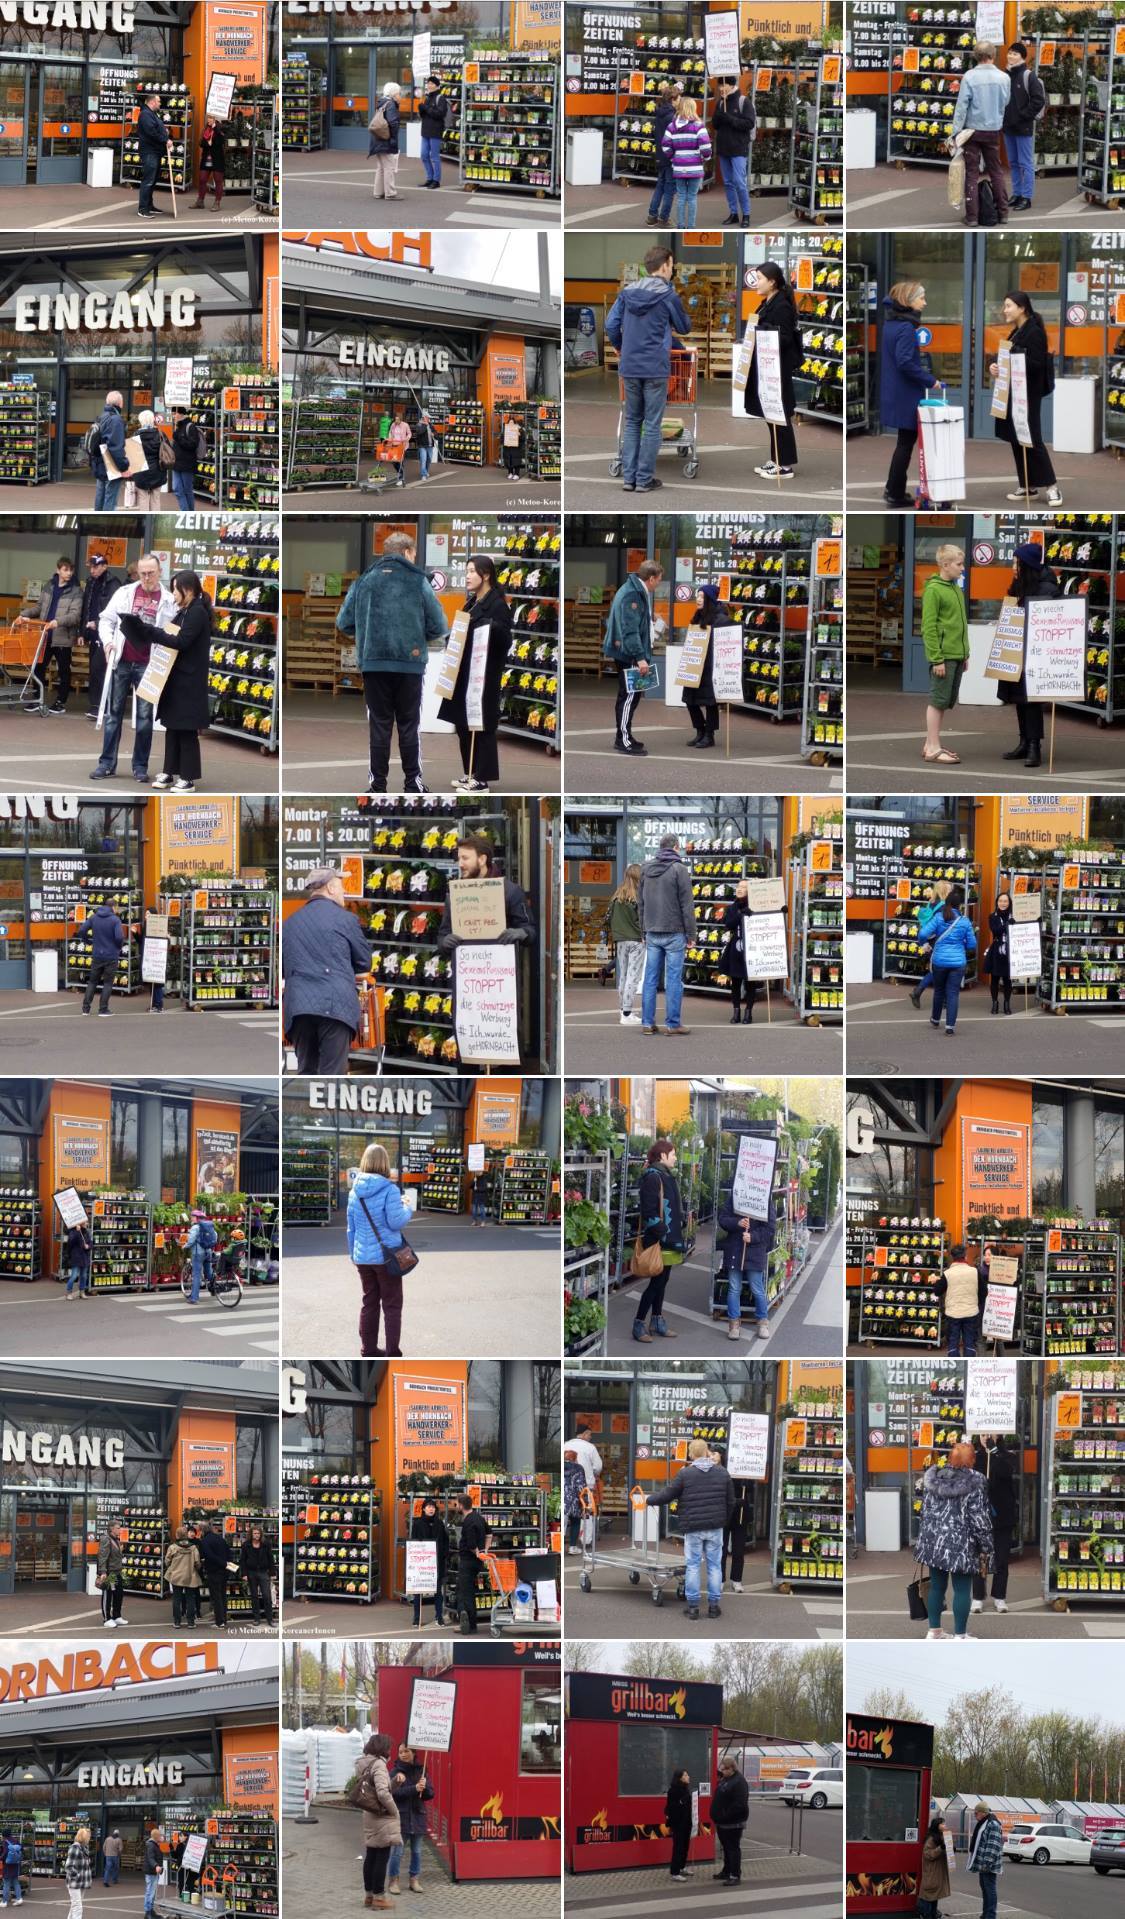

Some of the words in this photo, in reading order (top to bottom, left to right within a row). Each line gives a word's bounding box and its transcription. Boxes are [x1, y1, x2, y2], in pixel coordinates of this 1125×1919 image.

[853, 2, 895, 15] ZEITEN
[583, 11, 641, 28] ÖFFNUNGS
[854, 20, 877, 30] Montag
[748, 18, 791, 34] Pünktlich
[795, 21, 811, 34] und
[584, 27, 623, 41] ZEITEN
[584, 45, 607, 55] Montag
[854, 48, 882, 57] Samstag
[600, 57, 609, 65] bis
[100, 67, 138, 78] ÖFFNUNGS
[584, 71, 610, 80] Samstag
[100, 78, 126, 87] ZEITEN
[15, 287, 196, 332] EINGANG
[339, 341, 449, 372] EINGANG
[478, 536, 490, 547] bis
[197, 554, 210, 565] bis
[714, 560, 725, 568] bis
[1032, 603, 1041, 613] So
[1034, 628, 1075, 642] STOPPT
[1030, 645, 1042, 656] die
[1045, 647, 1083, 659] schmutzige
[1050, 657, 1079, 669] Werbung
[1027, 796, 1060, 805] SERVICE
[174, 820, 222, 830] HANDWERKER-
[644, 821, 706, 835] ÖFFNUNGS
[855, 822, 910, 839] ÖFFNUNGS
[185, 830, 212, 840] SERVICE
[285, 829, 311, 842] 7.00
[1009, 828, 1052, 843] Pünktlich
[855, 837, 893, 850] ZEITEN
[168, 859, 206, 870] Pünktlich
[856, 854, 878, 863] Montag
[42, 859, 88, 871] ÖFFNUNGS
[42, 871, 74, 881] ZEITEN
[856, 879, 880, 888] Samstag
[750, 932, 778, 943] STOPPT
[460, 949, 469, 960] So
[463, 978, 504, 994] STOPPT
[461, 998, 472, 1010] die
[476, 1001, 514, 1014] schmutzige
[481, 1012, 511, 1027] Werbung
[309, 1081, 432, 1116] EINGANG
[974, 1164, 1017, 1173] HANDWERKER-
[983, 1174, 1009, 1183] SERVICE
[969, 1202, 1004, 1214] Pünktlich
[887, 1371, 935, 1385] ZEITEN
[974, 1376, 1008, 1387] STOPPT
[652, 1384, 708, 1399] ÖFFNUNGS
[407, 1412, 419, 1420] DER
[408, 1421, 452, 1429] HANDWERKER-
[418, 1430, 444, 1439] SERVICE
[2, 1430, 124, 1468] NGANG
[403, 1459, 440, 1471] Pünktlich
[442, 1461, 455, 1471] und
[611, 1682, 672, 1713] grillbar
[847, 1719, 877, 1751] bar
[77, 1760, 184, 1789] EINGANG
[471, 1820, 508, 1840] grillbar
[584, 1828, 611, 1842] grillbar
